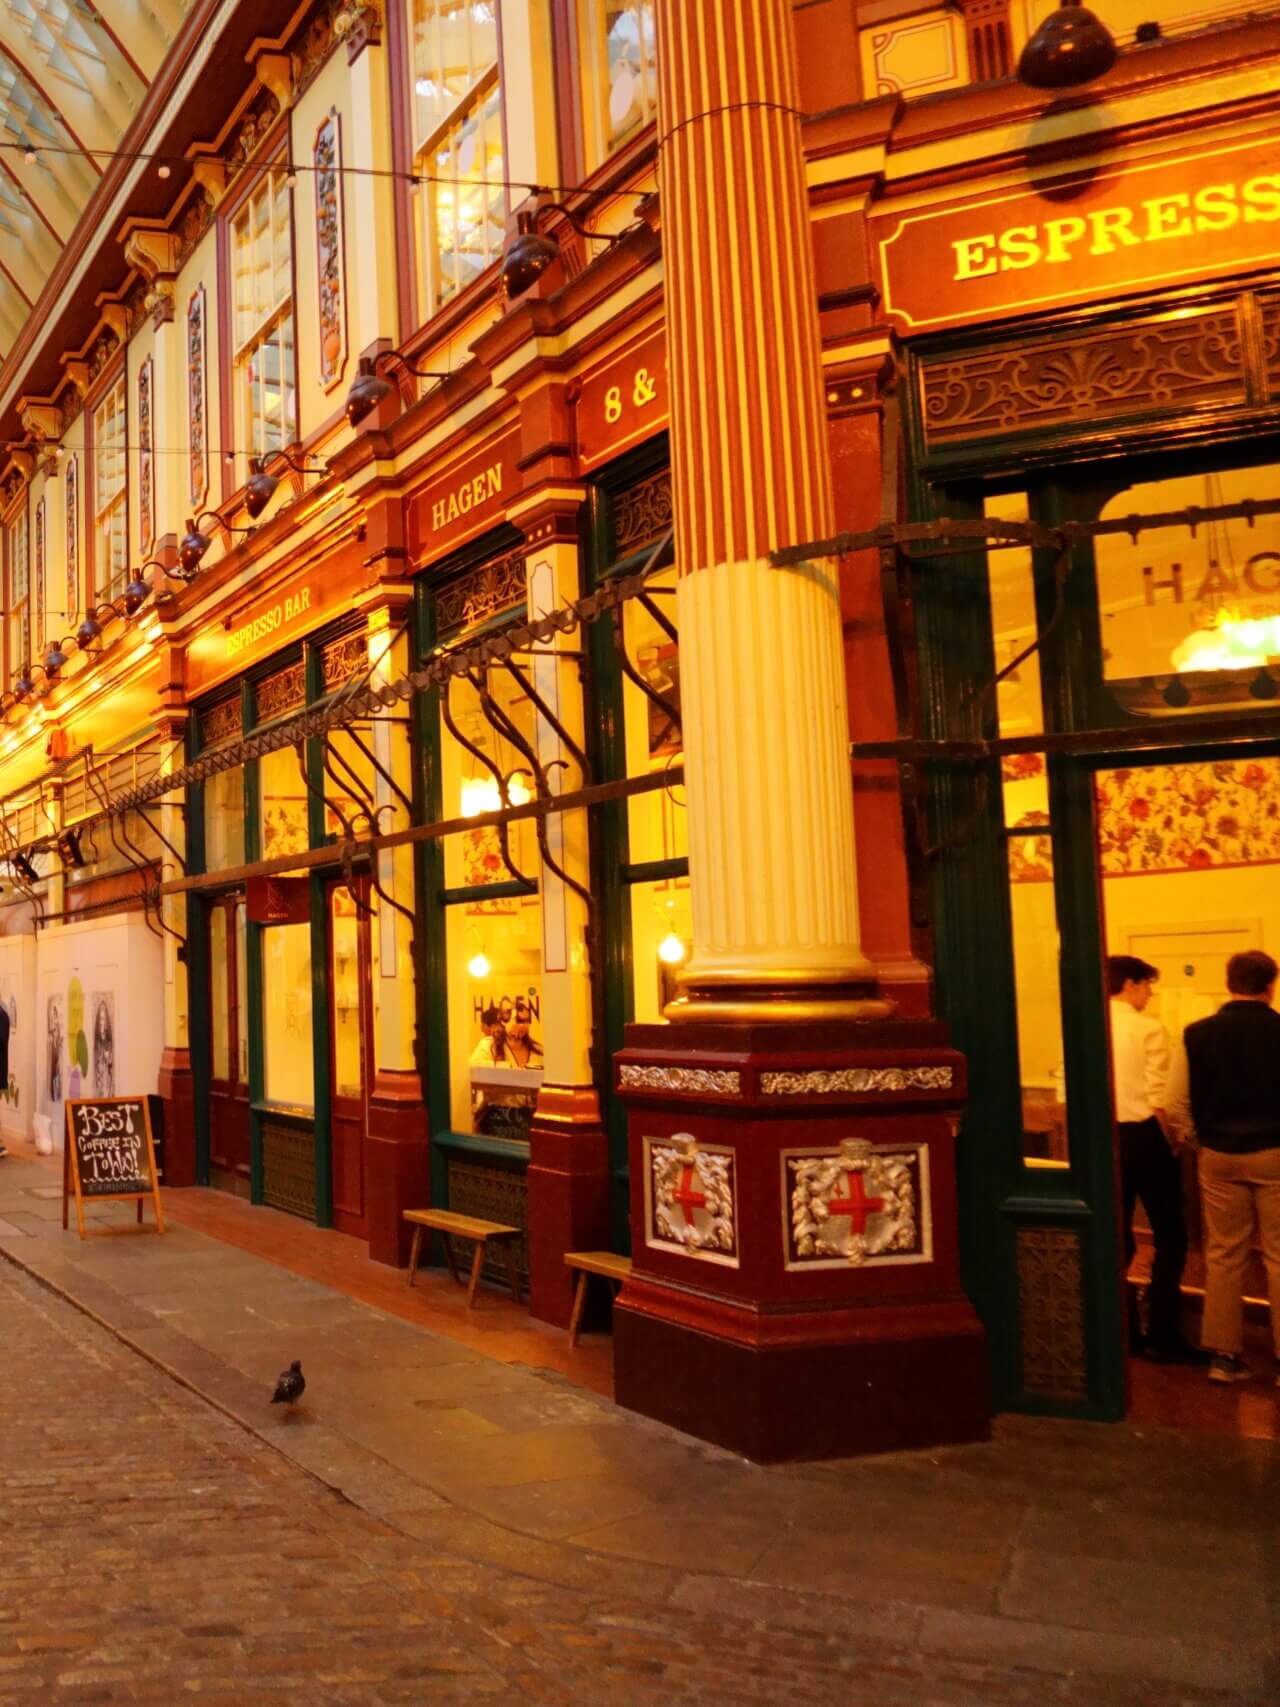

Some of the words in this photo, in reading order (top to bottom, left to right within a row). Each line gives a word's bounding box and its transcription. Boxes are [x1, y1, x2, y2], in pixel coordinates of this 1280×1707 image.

[951, 173, 1280, 281] ESPRESS
[604, 386, 621, 423] 8
[633, 368, 656, 407] &
[431, 462, 503, 532] HAGEN
[226, 605, 282, 657] ESPRESSO
[285, 587, 311, 622] BAR
